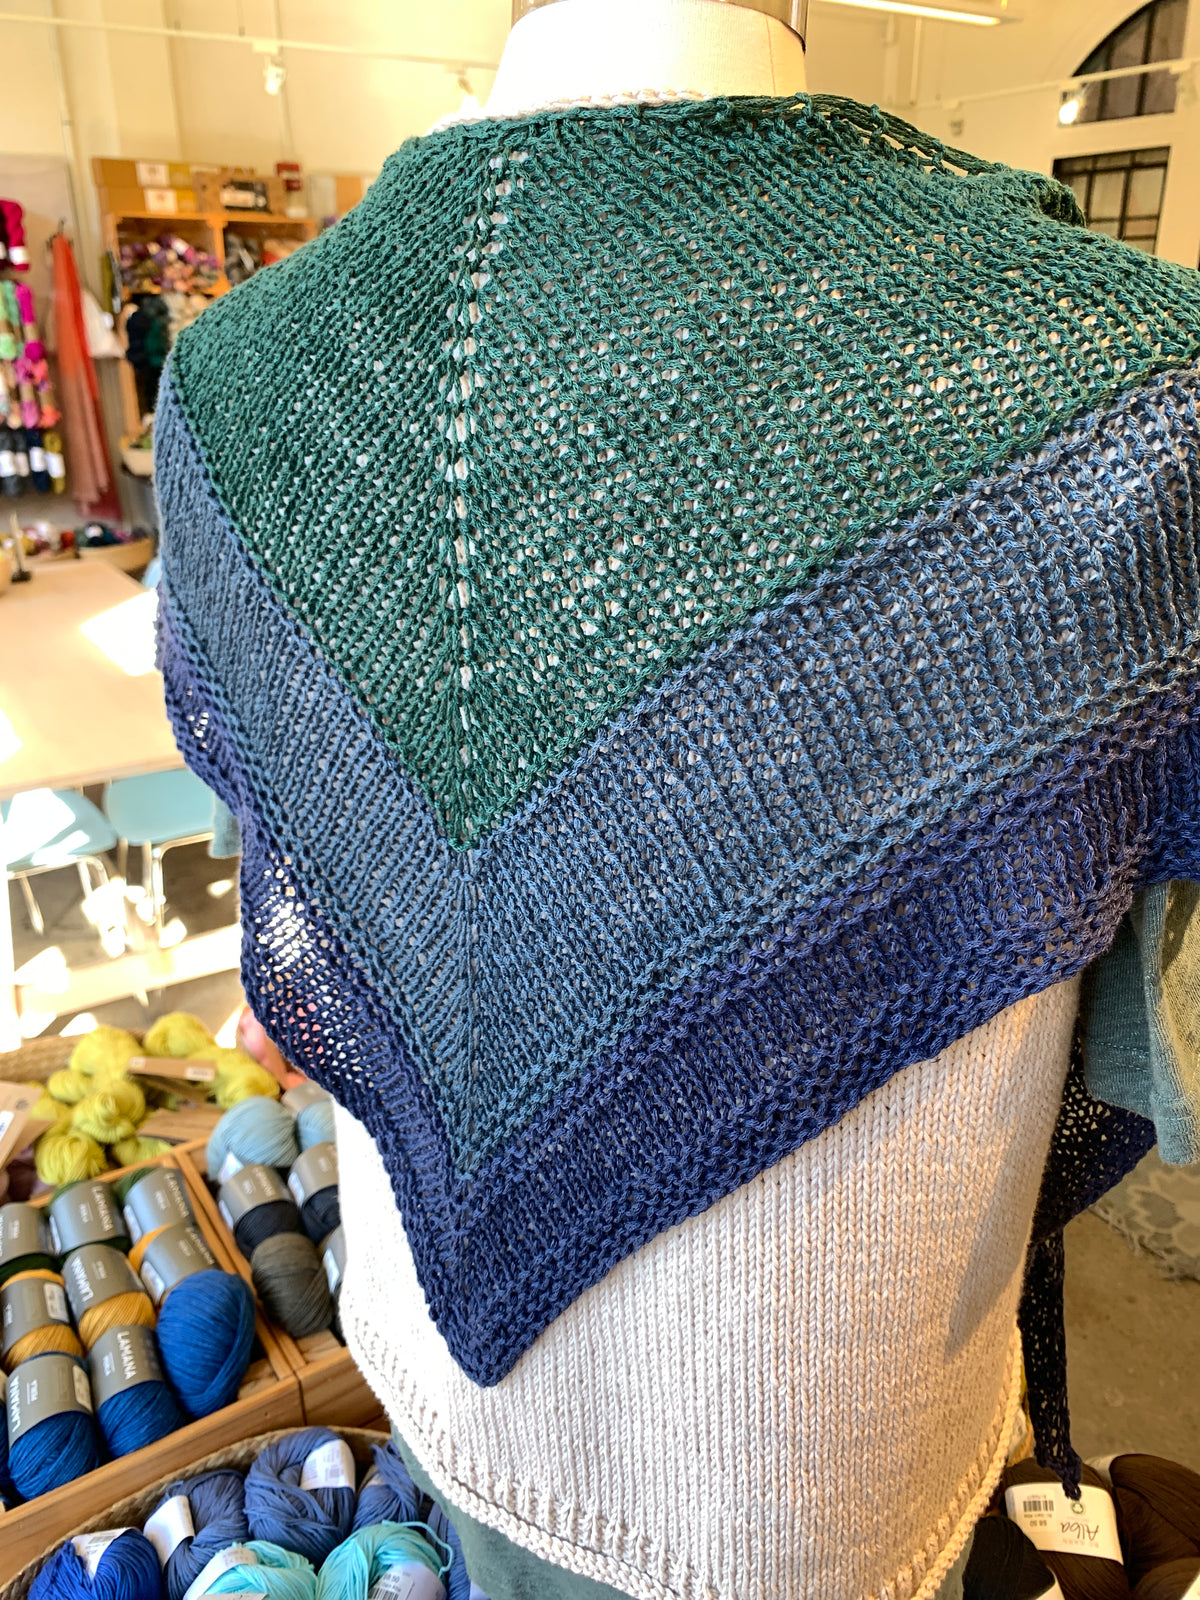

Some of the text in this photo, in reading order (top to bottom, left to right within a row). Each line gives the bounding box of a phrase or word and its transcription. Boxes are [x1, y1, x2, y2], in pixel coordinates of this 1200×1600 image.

[71, 1256, 94, 1302] LAMANA
[117, 1331, 137, 1380] LAMANA
[9, 1376, 21, 1433] LAMANA
[1060, 1521, 1099, 1541] Alba
